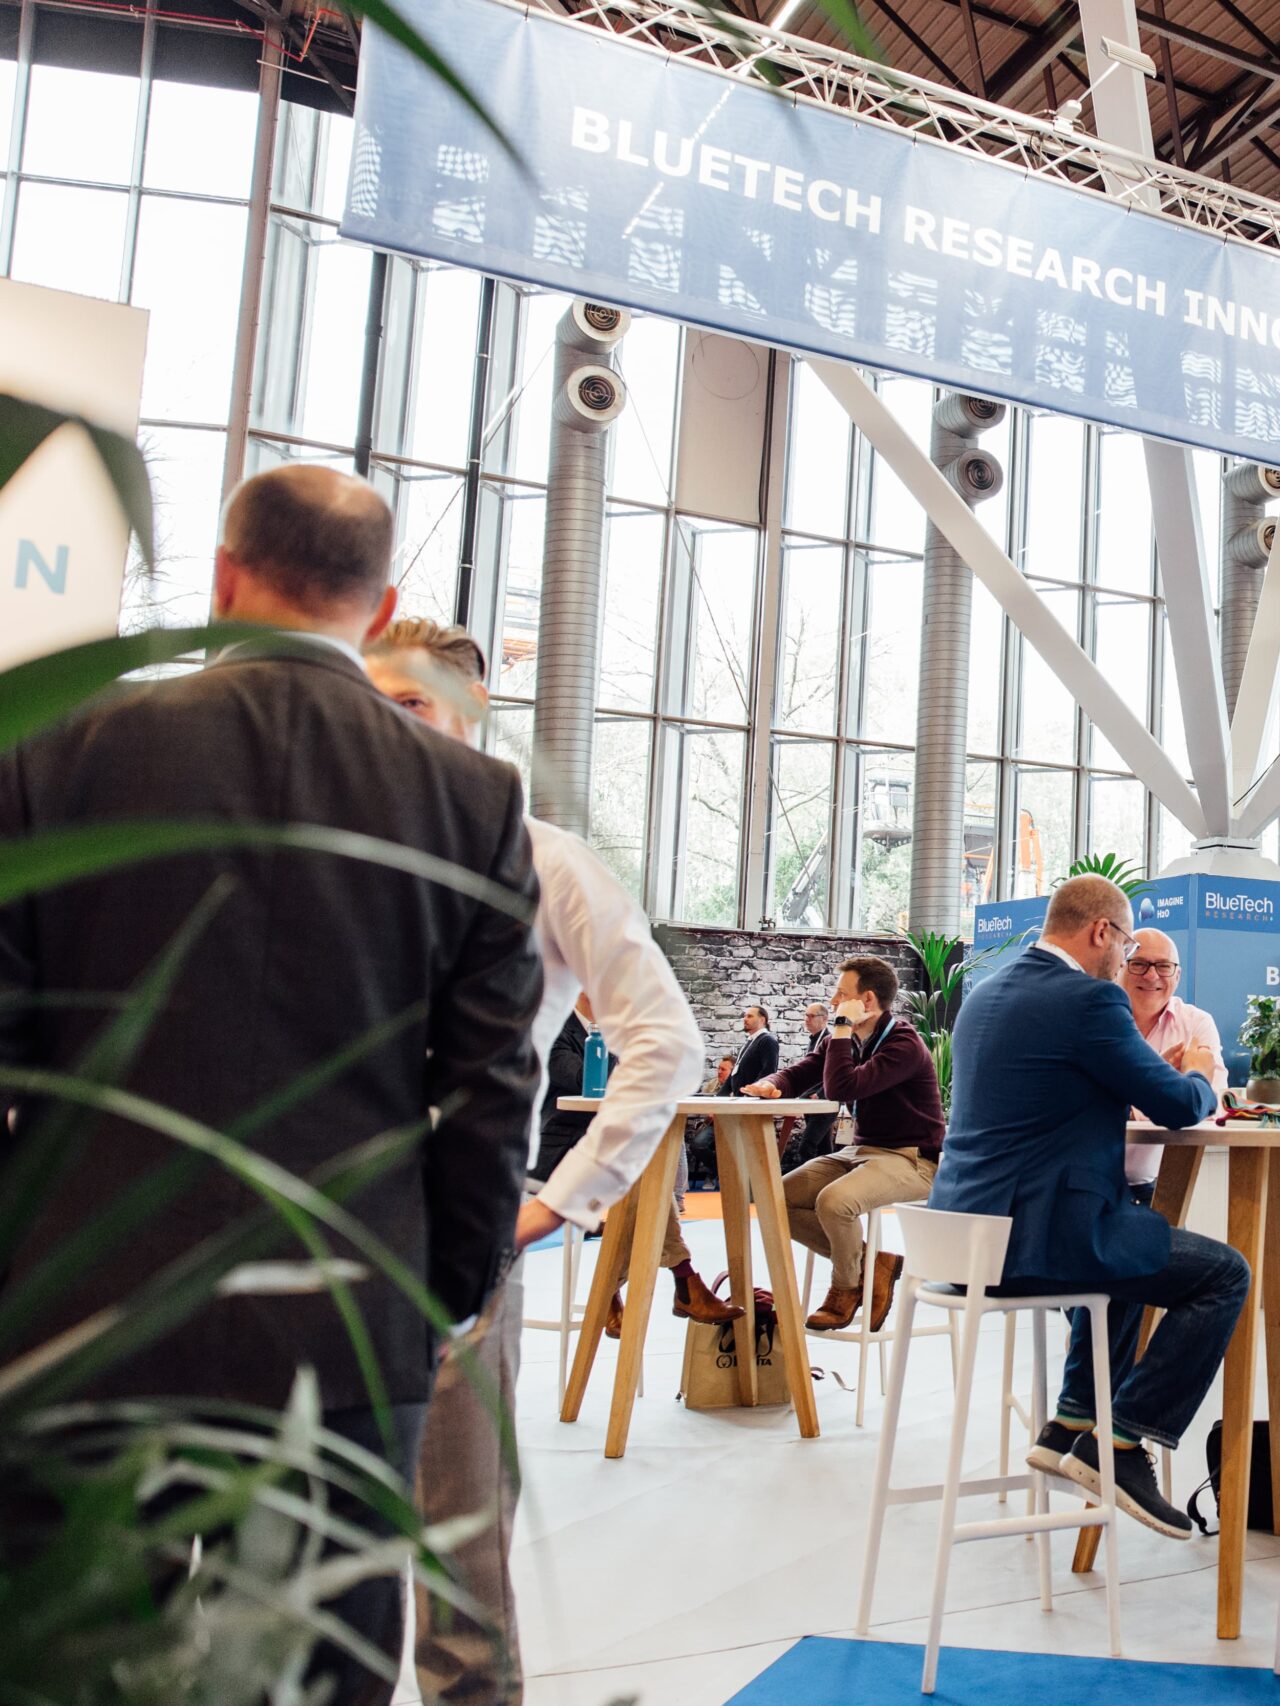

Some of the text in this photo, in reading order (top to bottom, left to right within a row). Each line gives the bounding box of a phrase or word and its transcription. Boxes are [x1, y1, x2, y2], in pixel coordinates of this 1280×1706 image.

[571, 106, 882, 235] BLUETECH
[903, 205, 1165, 316] RESEARCH
[1157, 895, 1184, 908] IMAGINE
[1205, 891, 1274, 914] BlueTech
[977, 915, 1012, 933] BlueTech
[1205, 909, 1269, 921] RESEARCH
